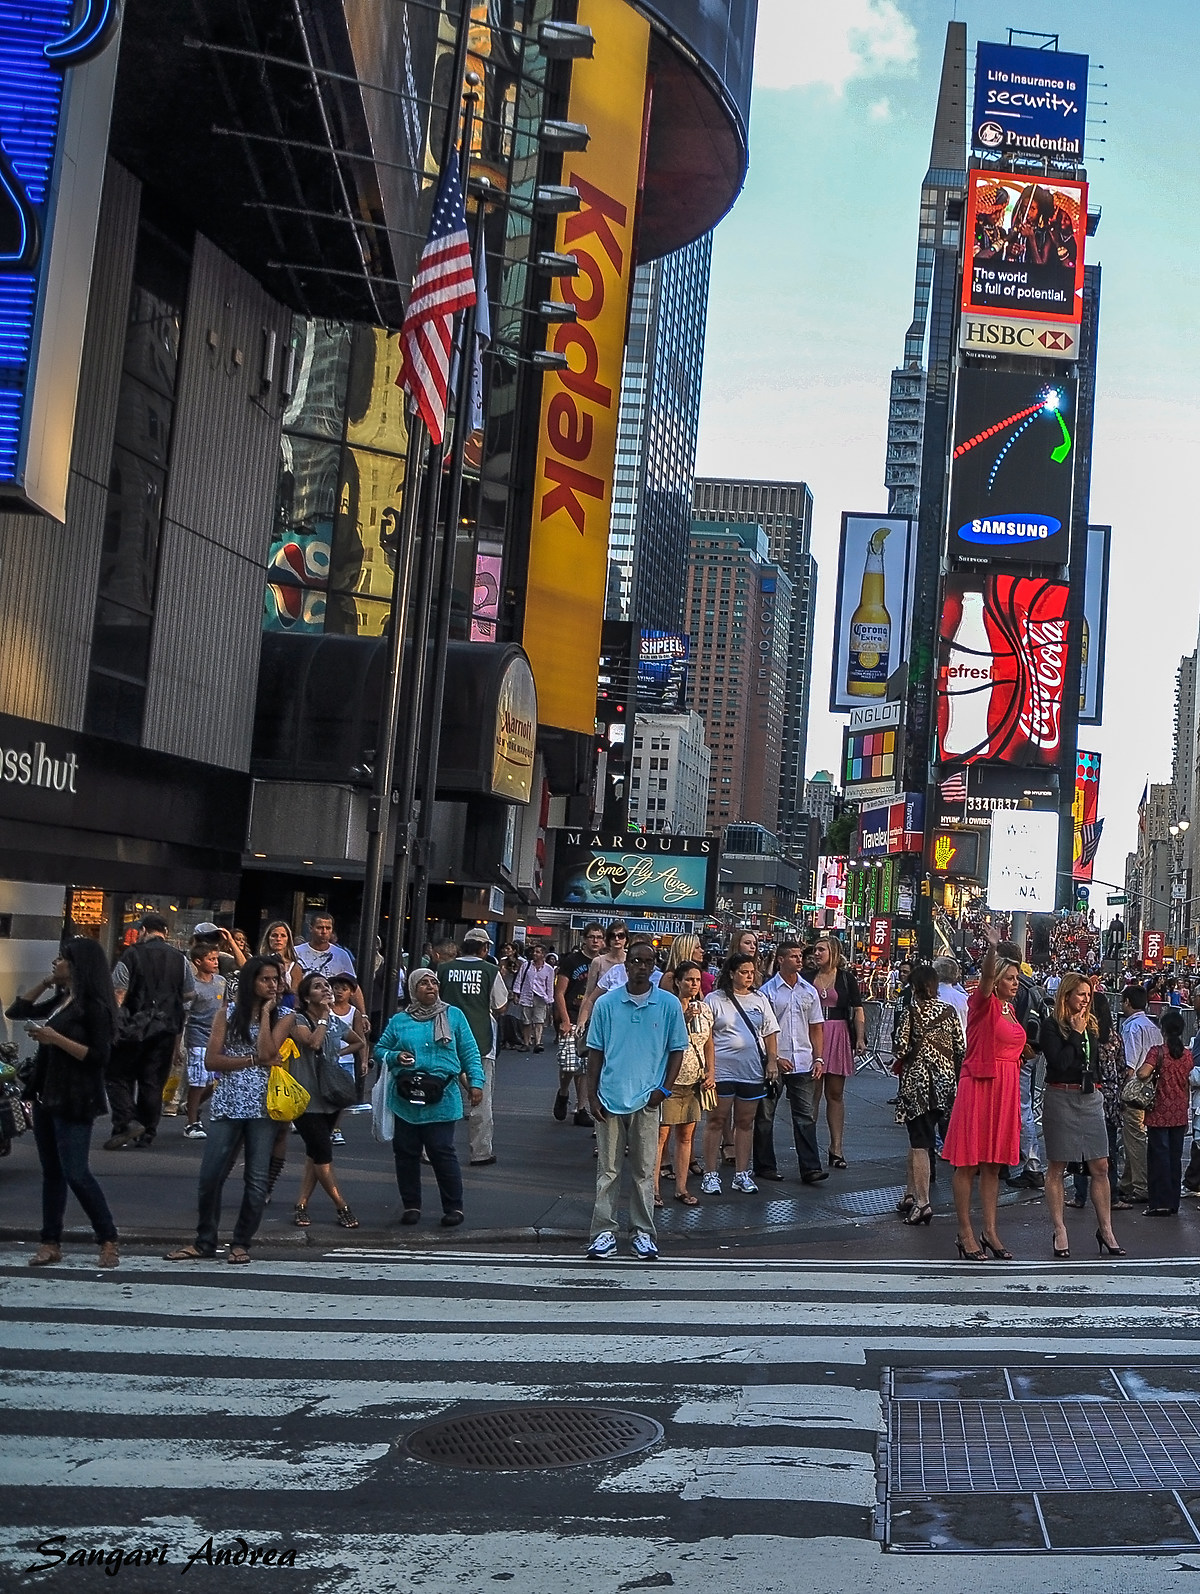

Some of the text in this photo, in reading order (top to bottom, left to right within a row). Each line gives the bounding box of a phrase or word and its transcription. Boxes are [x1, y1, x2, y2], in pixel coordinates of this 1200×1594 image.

[988, 70, 1009, 82] Life
[987, 89, 1078, 117] security.
[1005, 130, 1080, 153] Prudential
[973, 267, 1028, 284] The world
[972, 280, 1067, 302] is full of potential.
[966, 321, 1035, 347] HSBC
[540, 170, 628, 537] Kodak
[971, 519, 1048, 539] SAMSUNG
[853, 623, 888, 638] Corona
[860, 633, 883, 641] Extra
[757, 596, 773, 695] NOVOTEL
[850, 704, 900, 725] INGLOT
[501, 711, 533, 741] Marriott
[905, 801, 915, 831] Travelex
[567, 833, 711, 853] MARQUIS
[862, 827, 889, 849] Travelex
[585, 854, 699, 903] Come Fly Away
[650, 920, 686, 933] SINATRA
[874, 920, 888, 945] tkts
[1147, 933, 1161, 958] tkts
[448, 969, 483, 983] PRIVATE
[462, 982, 482, 995] EYES
